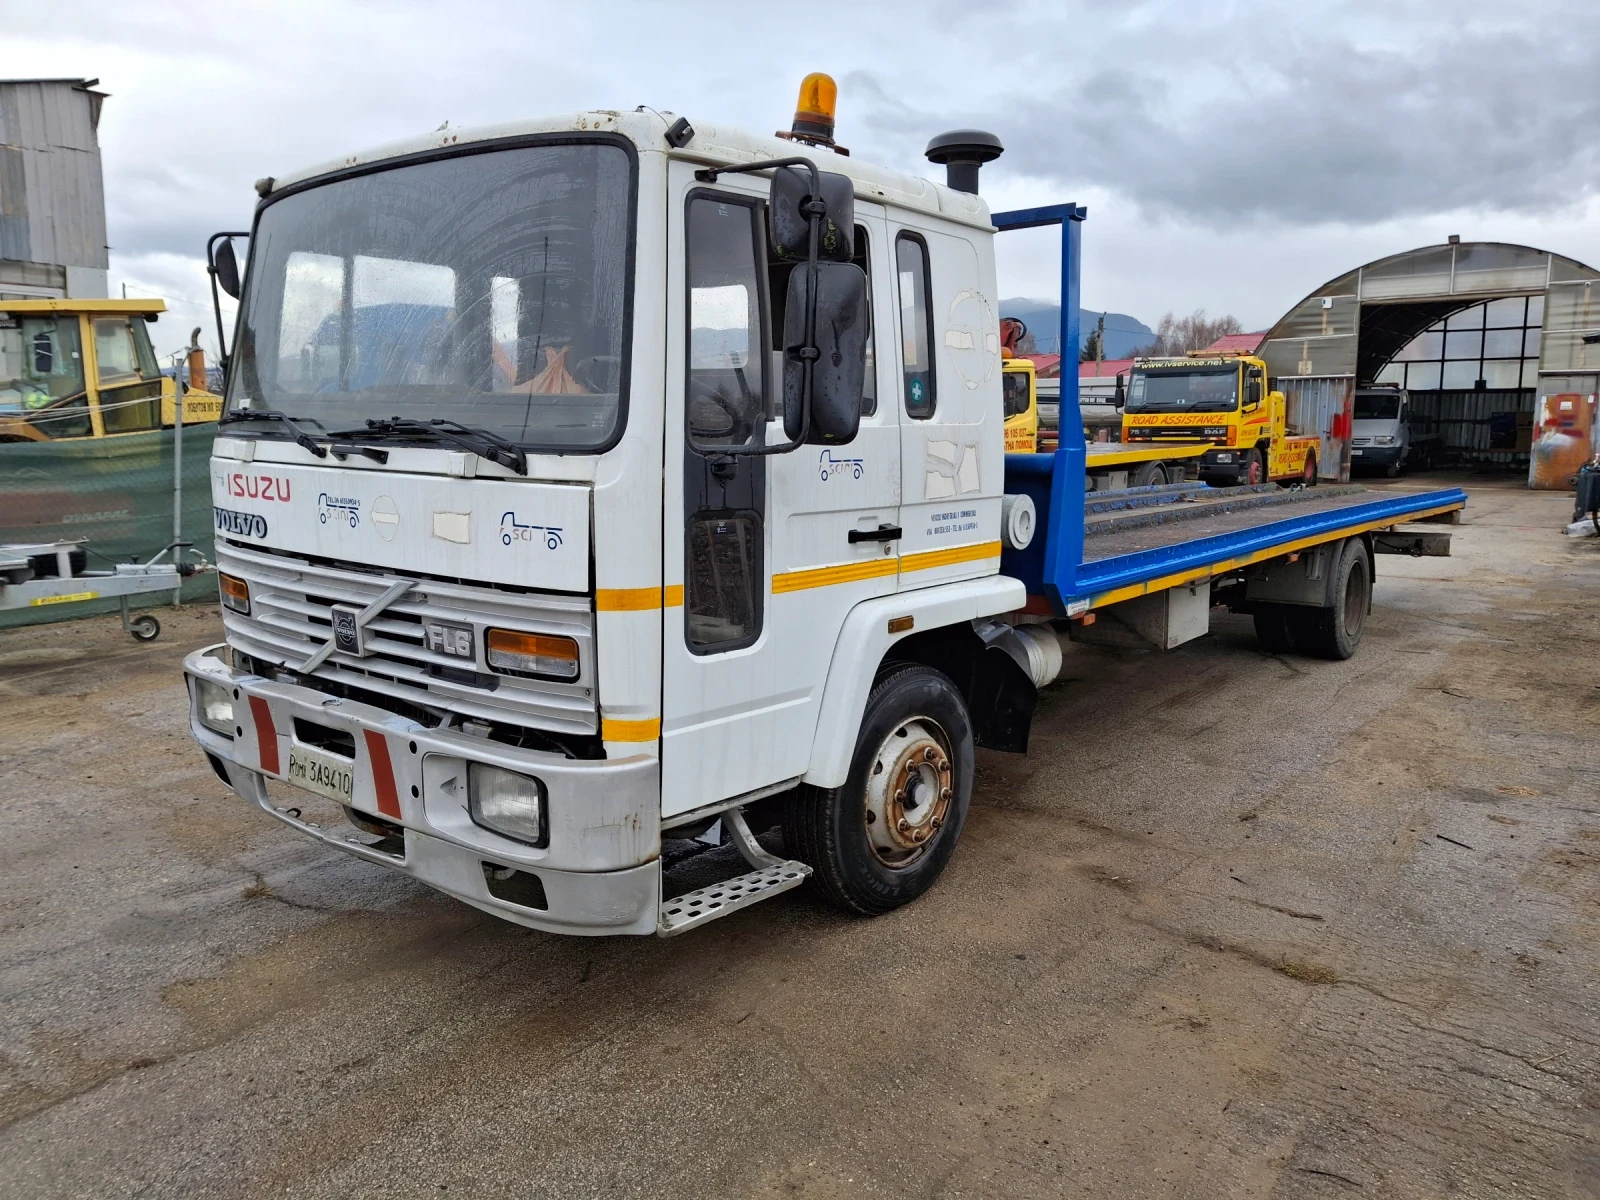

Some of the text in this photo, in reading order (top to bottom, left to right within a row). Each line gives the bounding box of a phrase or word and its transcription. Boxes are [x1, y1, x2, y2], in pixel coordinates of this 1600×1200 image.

[1131, 414, 1226, 425] ROAD ASSISTANCE
[227, 473, 291, 502] ISUZU
[213, 506, 268, 538] VOLVO
[337, 627, 355, 637] VOLVO
[429, 625, 471, 657] FL6
[310, 760, 350, 795] 3A9410
